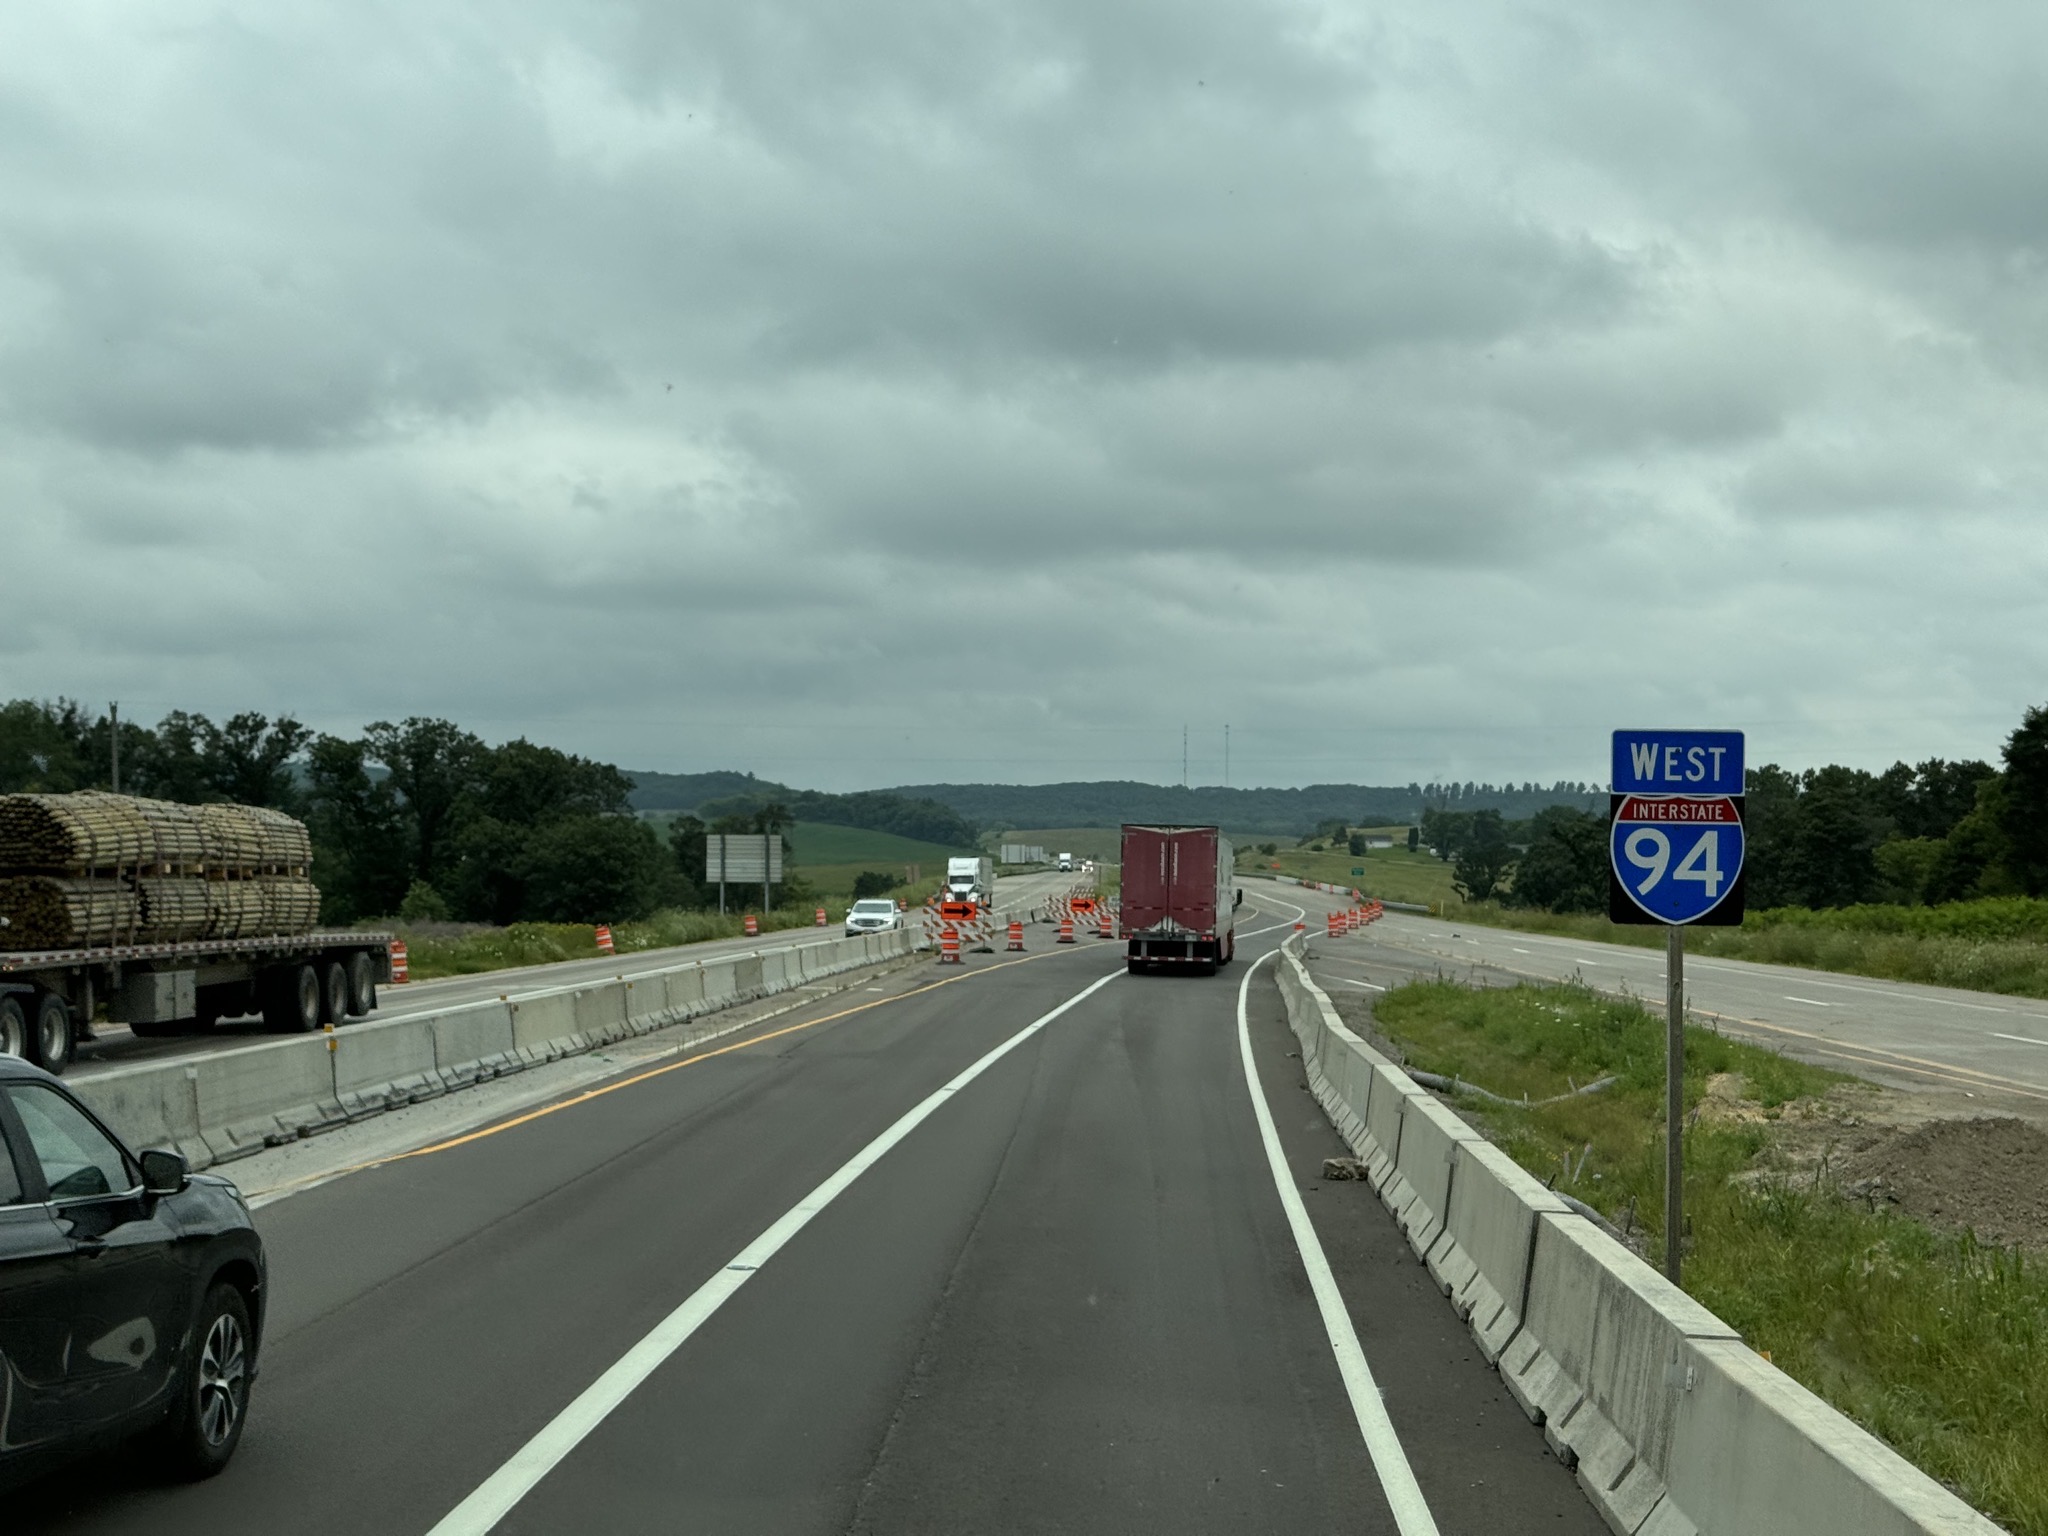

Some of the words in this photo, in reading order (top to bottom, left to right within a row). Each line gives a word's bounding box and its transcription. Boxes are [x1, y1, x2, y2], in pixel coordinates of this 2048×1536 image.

[1631, 743, 1727, 781] WEST
[1633, 803, 1724, 821] INTERSTATE
[1625, 828, 1724, 897] 94
